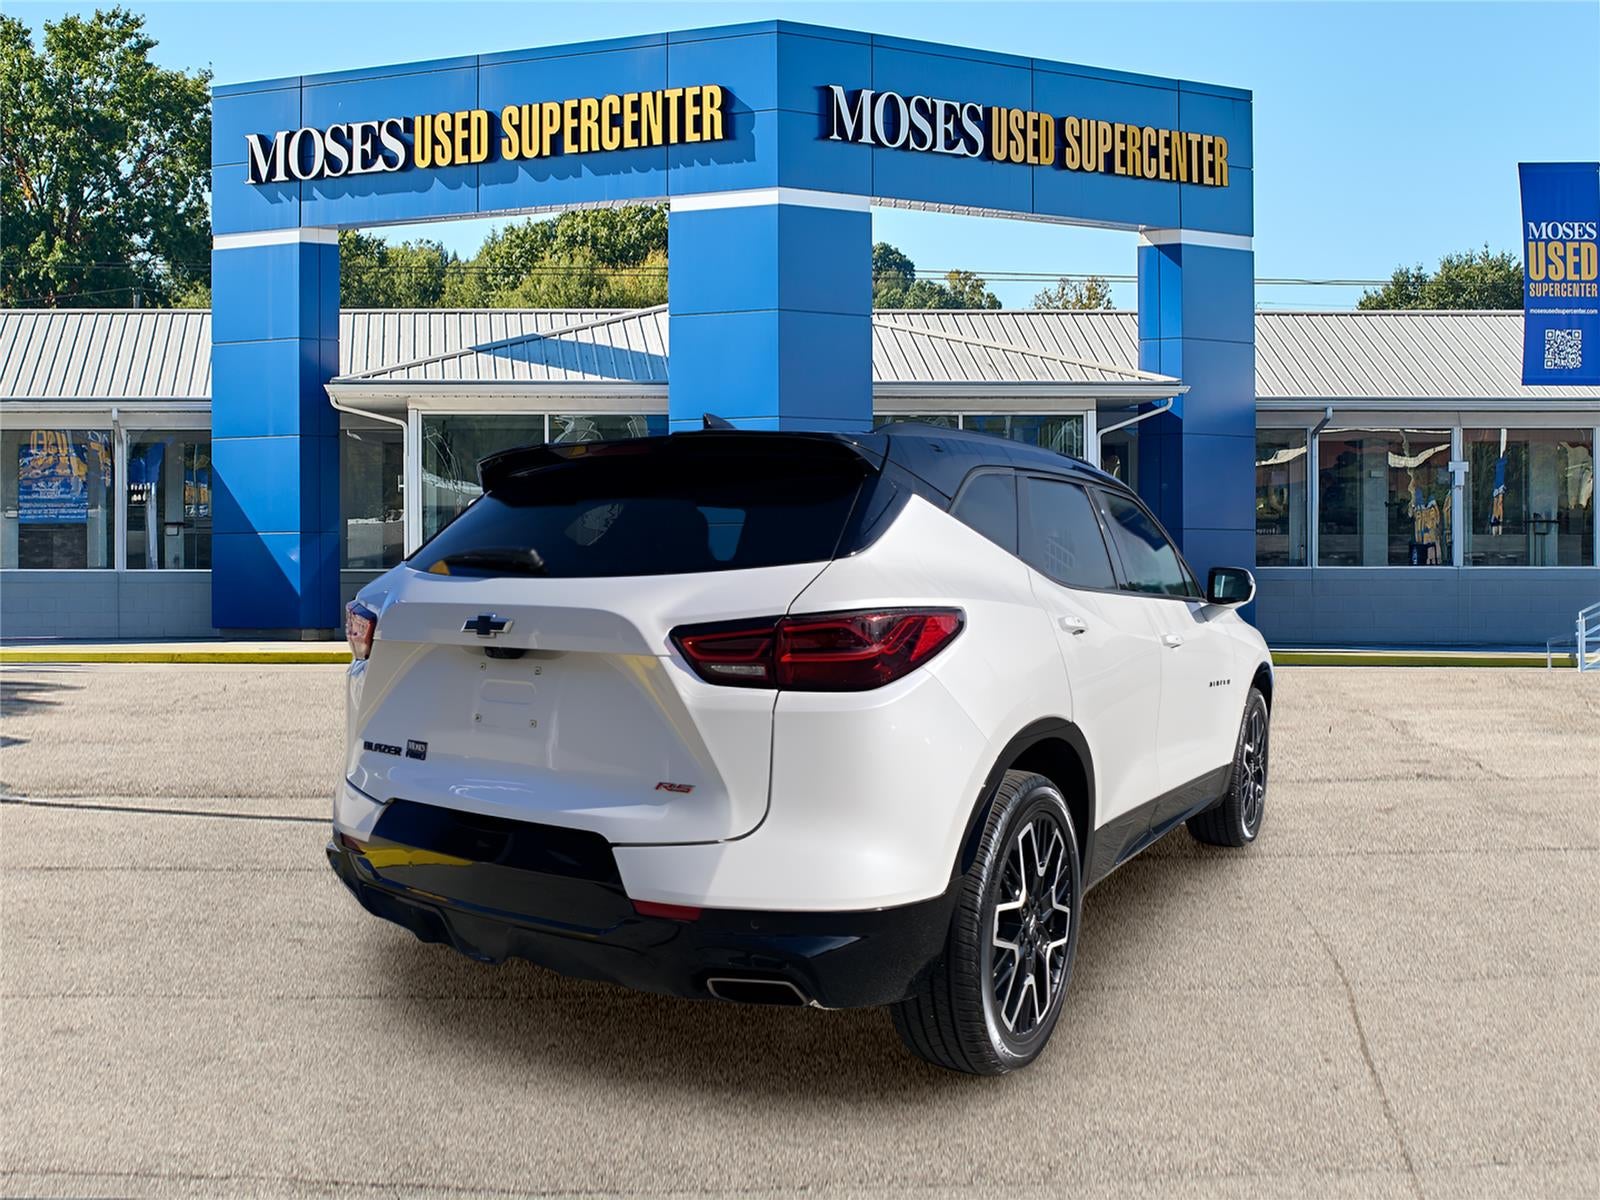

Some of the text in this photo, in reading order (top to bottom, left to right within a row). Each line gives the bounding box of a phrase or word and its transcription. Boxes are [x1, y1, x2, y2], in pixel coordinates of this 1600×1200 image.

[244, 85, 725, 185] MOSES USED SUPERCENTER
[828, 84, 1230, 187] MOSES USED SUPERCENTER
[1527, 221, 1598, 241] MOSES
[1527, 241, 1599, 282] USED
[1529, 282, 1598, 298] SUPERCENTER
[363, 740, 403, 757] BLAZER
